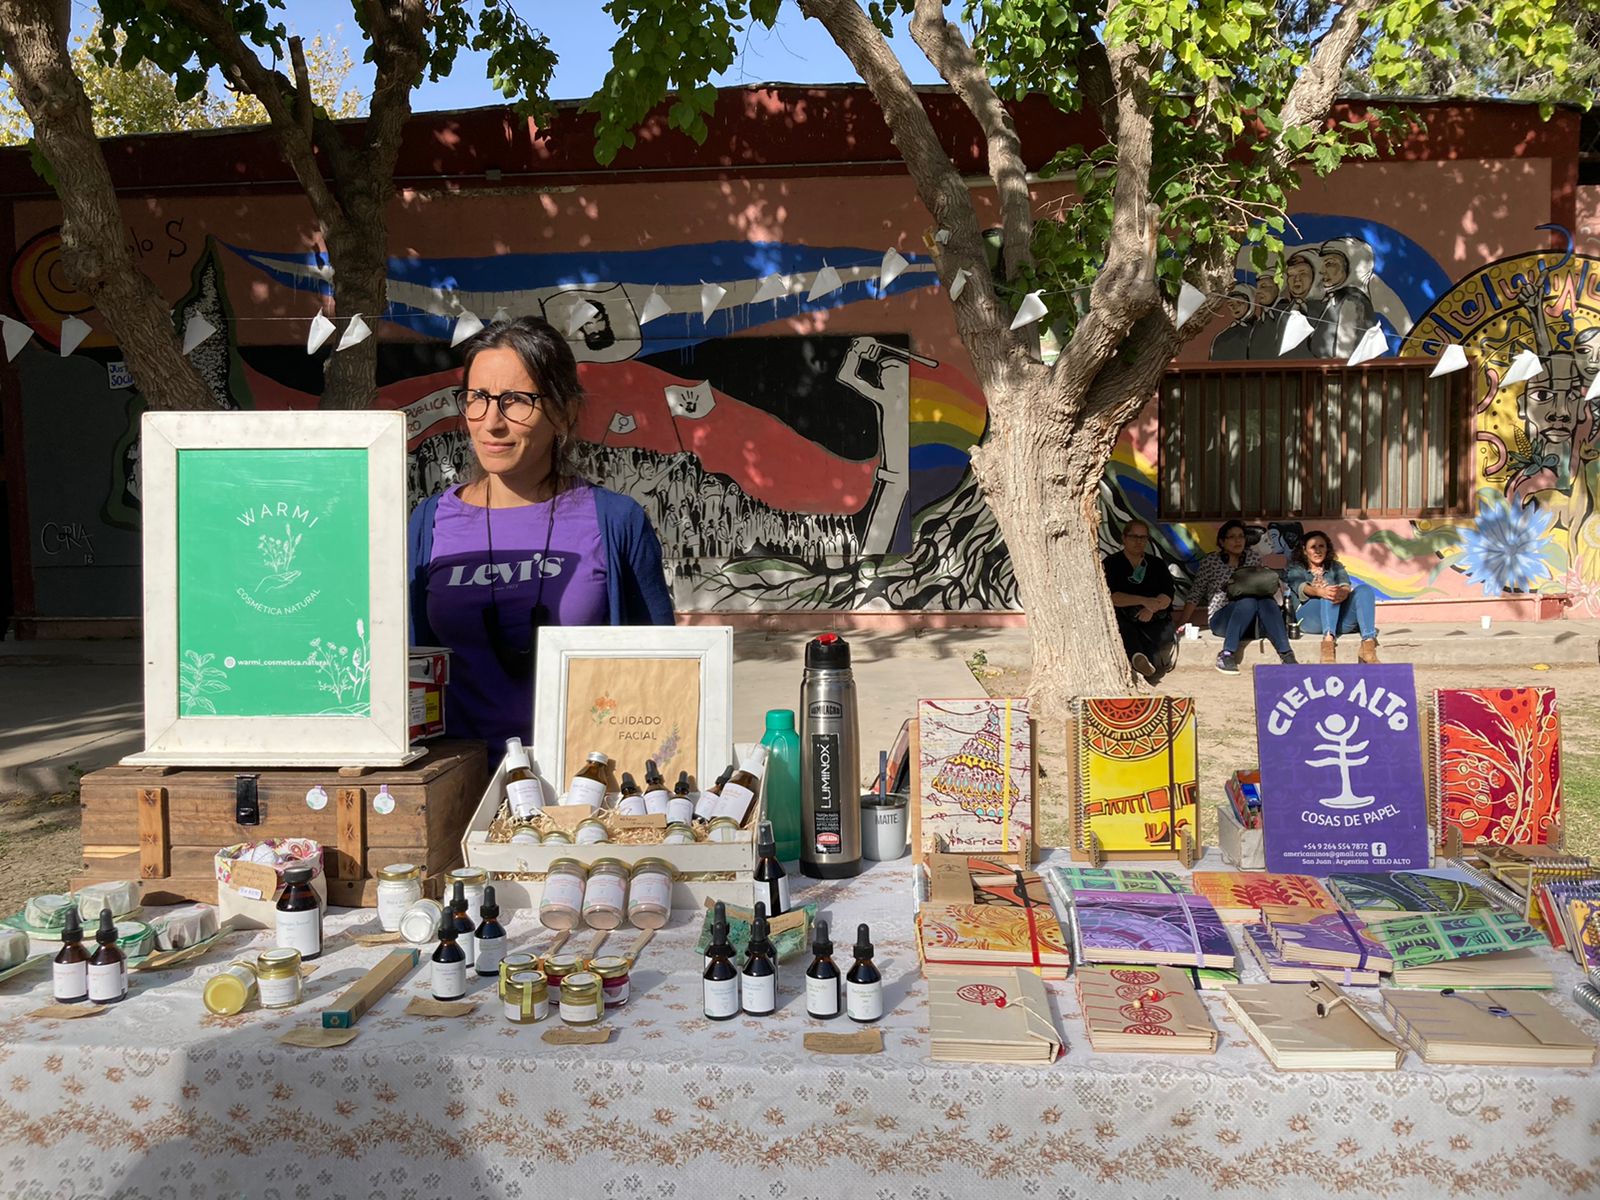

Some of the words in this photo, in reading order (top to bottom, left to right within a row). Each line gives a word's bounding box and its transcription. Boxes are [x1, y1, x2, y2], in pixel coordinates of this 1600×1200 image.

[237, 501, 319, 529] WARMI
[236, 587, 283, 616] COSMETICA
[284, 588, 321, 616] NATURAL
[1267, 675, 1345, 736] CIELO
[1347, 678, 1409, 732] ALTO
[609, 716, 662, 726] CUIDADO
[618, 731, 657, 740] FACIAL
[820, 744, 832, 809] LUMINOX
[875, 813, 898, 825] MATTE
[1301, 810, 1341, 826] COSAS
[1344, 814, 1362, 826] DE
[1363, 804, 1401, 825] PAPEL
[1335, 858, 1369, 866] Argentina
